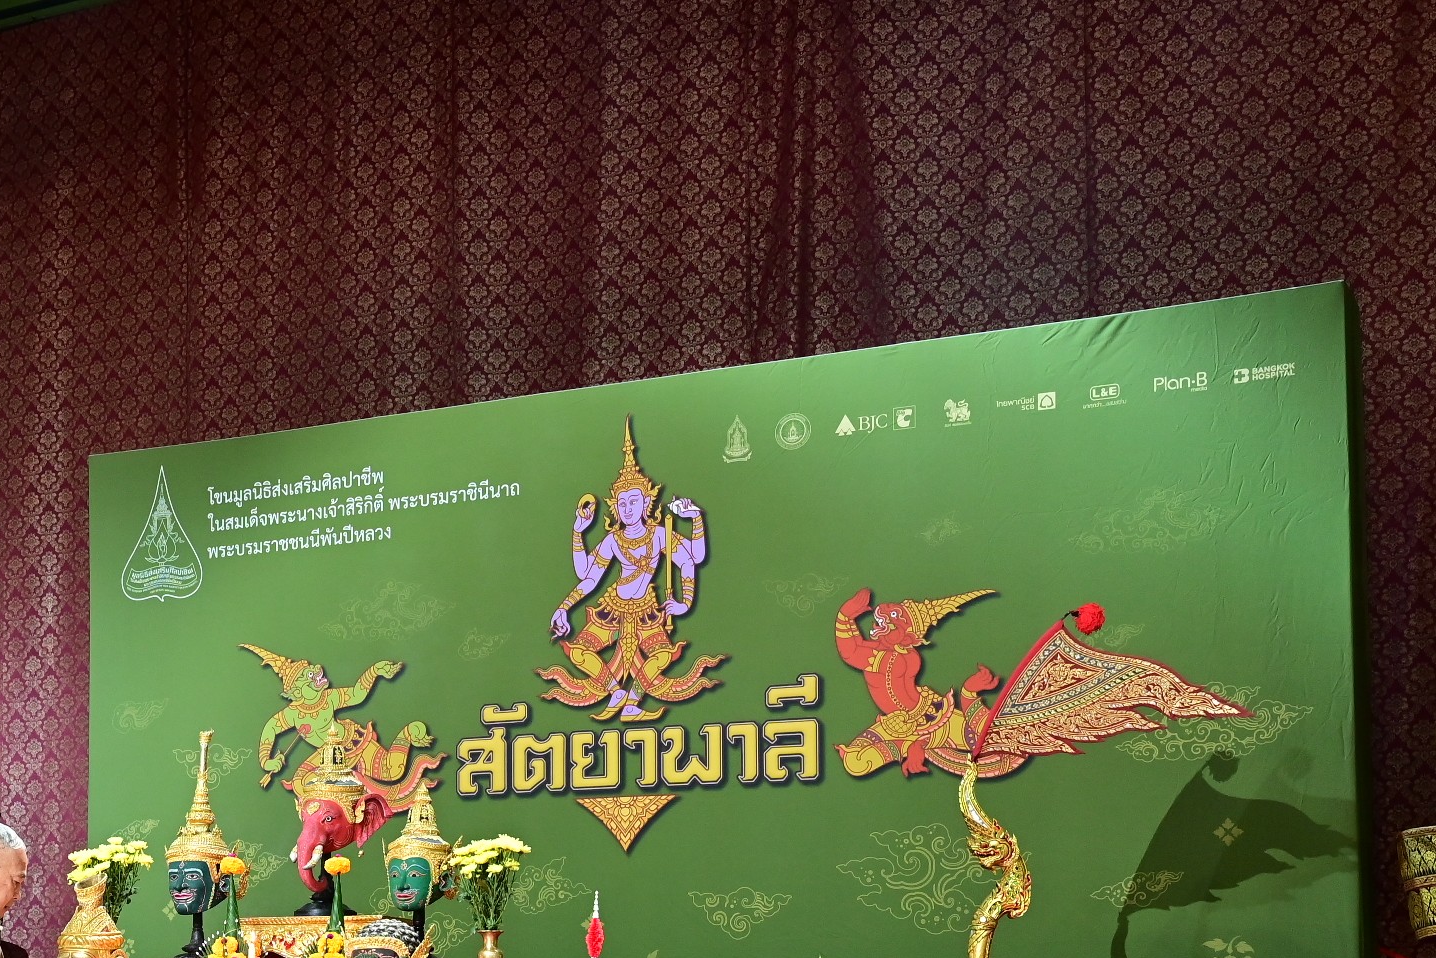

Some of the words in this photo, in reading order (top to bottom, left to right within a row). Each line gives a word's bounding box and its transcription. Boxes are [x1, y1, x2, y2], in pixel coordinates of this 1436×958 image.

[1252, 362, 1295, 375] BANGKOK
[1252, 369, 1295, 381] HOSPITAL
[1092, 386, 1118, 398] L&E
[858, 413, 888, 433] BJC
[207, 466, 384, 507] โขนมูลนิธิส่งเสริมศิลปาชีพ
[207, 486, 385, 532] ในสมเด็จพระนางเจ้าสิริกิติ์
[388, 479, 520, 511] พระบรมราชินีนาถ
[207, 524, 391, 559] พระบรมราชชนนีพันปีหลวง
[456, 673, 820, 796] สัตยาพาลี
